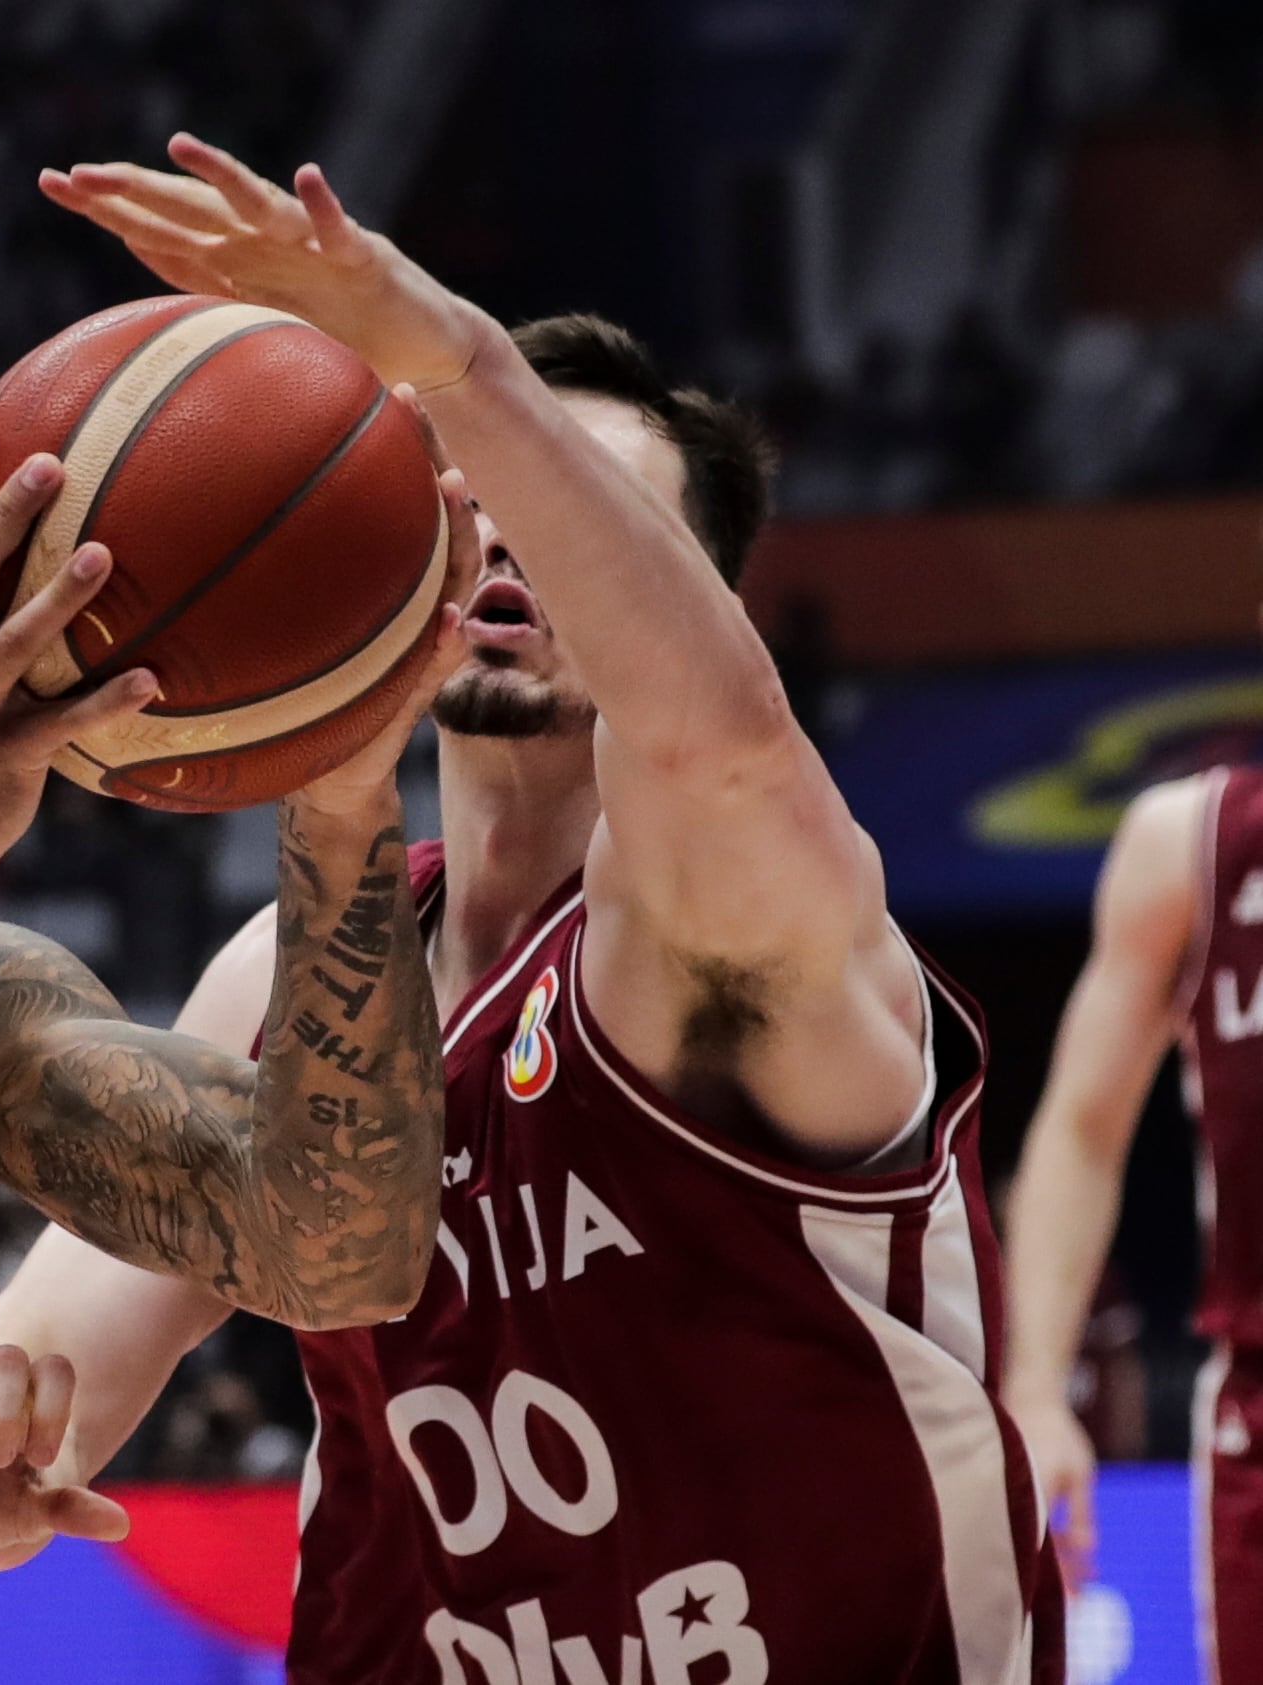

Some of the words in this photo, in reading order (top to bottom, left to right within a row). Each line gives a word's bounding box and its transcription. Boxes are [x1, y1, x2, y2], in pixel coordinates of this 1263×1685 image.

[291, 1009, 386, 1085] THE
[307, 1093, 359, 1128] IS
[386, 1369, 619, 1557] 00
